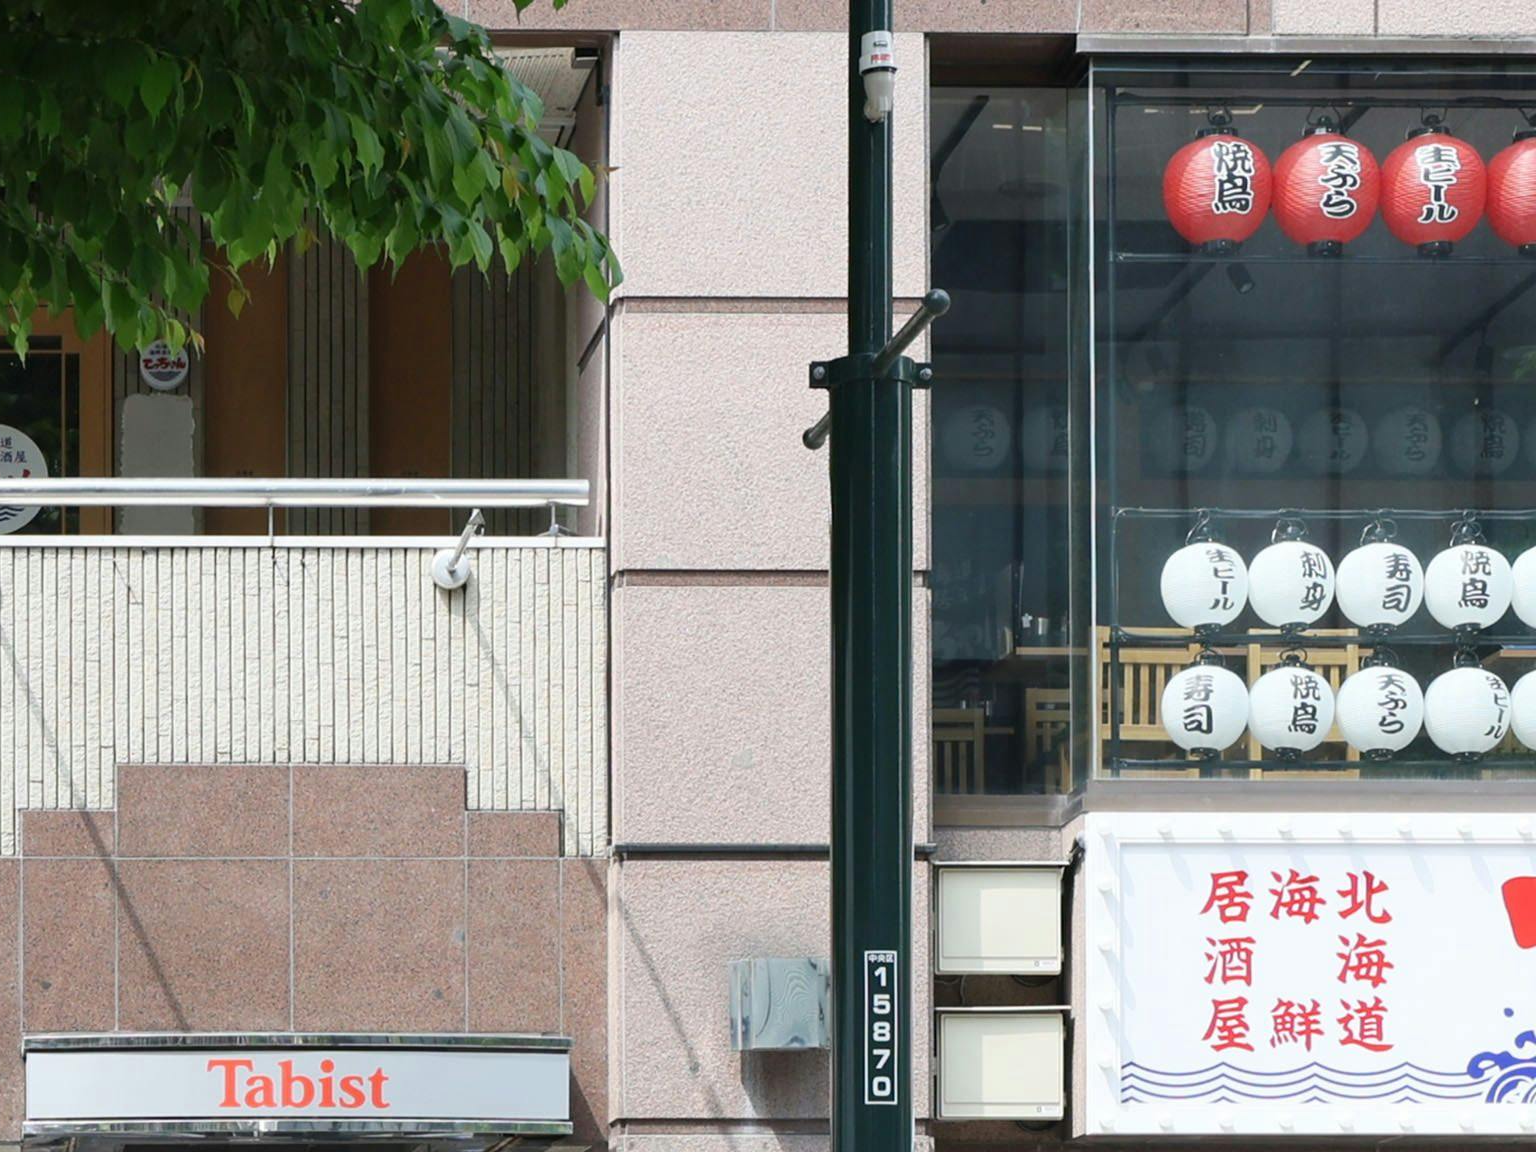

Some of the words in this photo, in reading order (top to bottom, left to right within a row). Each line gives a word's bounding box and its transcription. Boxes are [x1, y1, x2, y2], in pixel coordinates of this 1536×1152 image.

[1212, 142, 1254, 214] 焼鳥
[1319, 142, 1361, 219] 天ぷら
[1415, 145, 1460, 223] 生ビール
[1206, 549, 1236, 611] 生ビール
[1299, 551, 1328, 612] 刺身
[1382, 553, 1412, 613] 寿司
[1458, 550, 1492, 609] 焼鳥
[1183, 674, 1214, 735] 寿司
[1288, 674, 1321, 735] 焼鳥
[1377, 674, 1408, 735] 天ぷら
[1484, 676, 1509, 740] 生ビール
[868, 954, 894, 963] 中央区
[1199, 870, 1256, 1054] 居酒屋
[1268, 869, 1327, 1053] 海鮮
[1335, 871, 1395, 1053] 北海道
[872, 966, 892, 1097] 15870
[207, 1058, 391, 1109] Tabist
